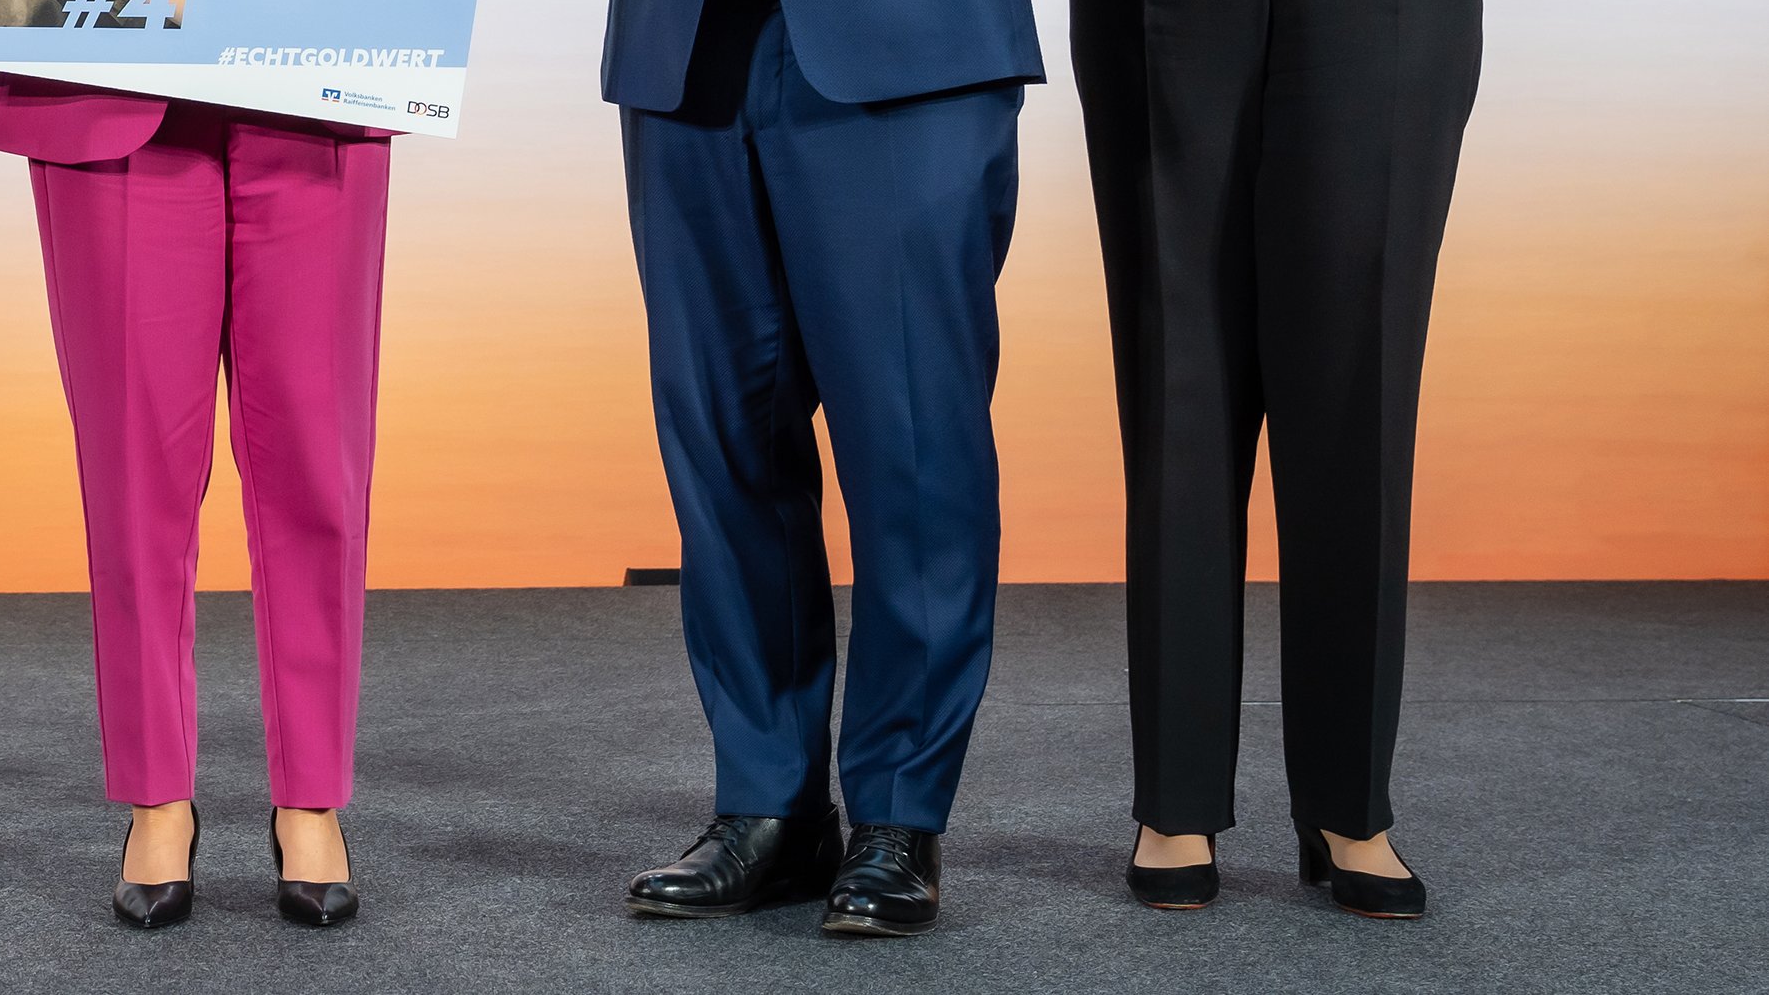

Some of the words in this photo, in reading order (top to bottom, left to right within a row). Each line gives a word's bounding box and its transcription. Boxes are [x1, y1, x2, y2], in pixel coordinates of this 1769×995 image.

[217, 46, 445, 68] #ECHTGOLDWERT
[344, 91, 382, 102] Volksbanken
[406, 100, 450, 119] DOSB
